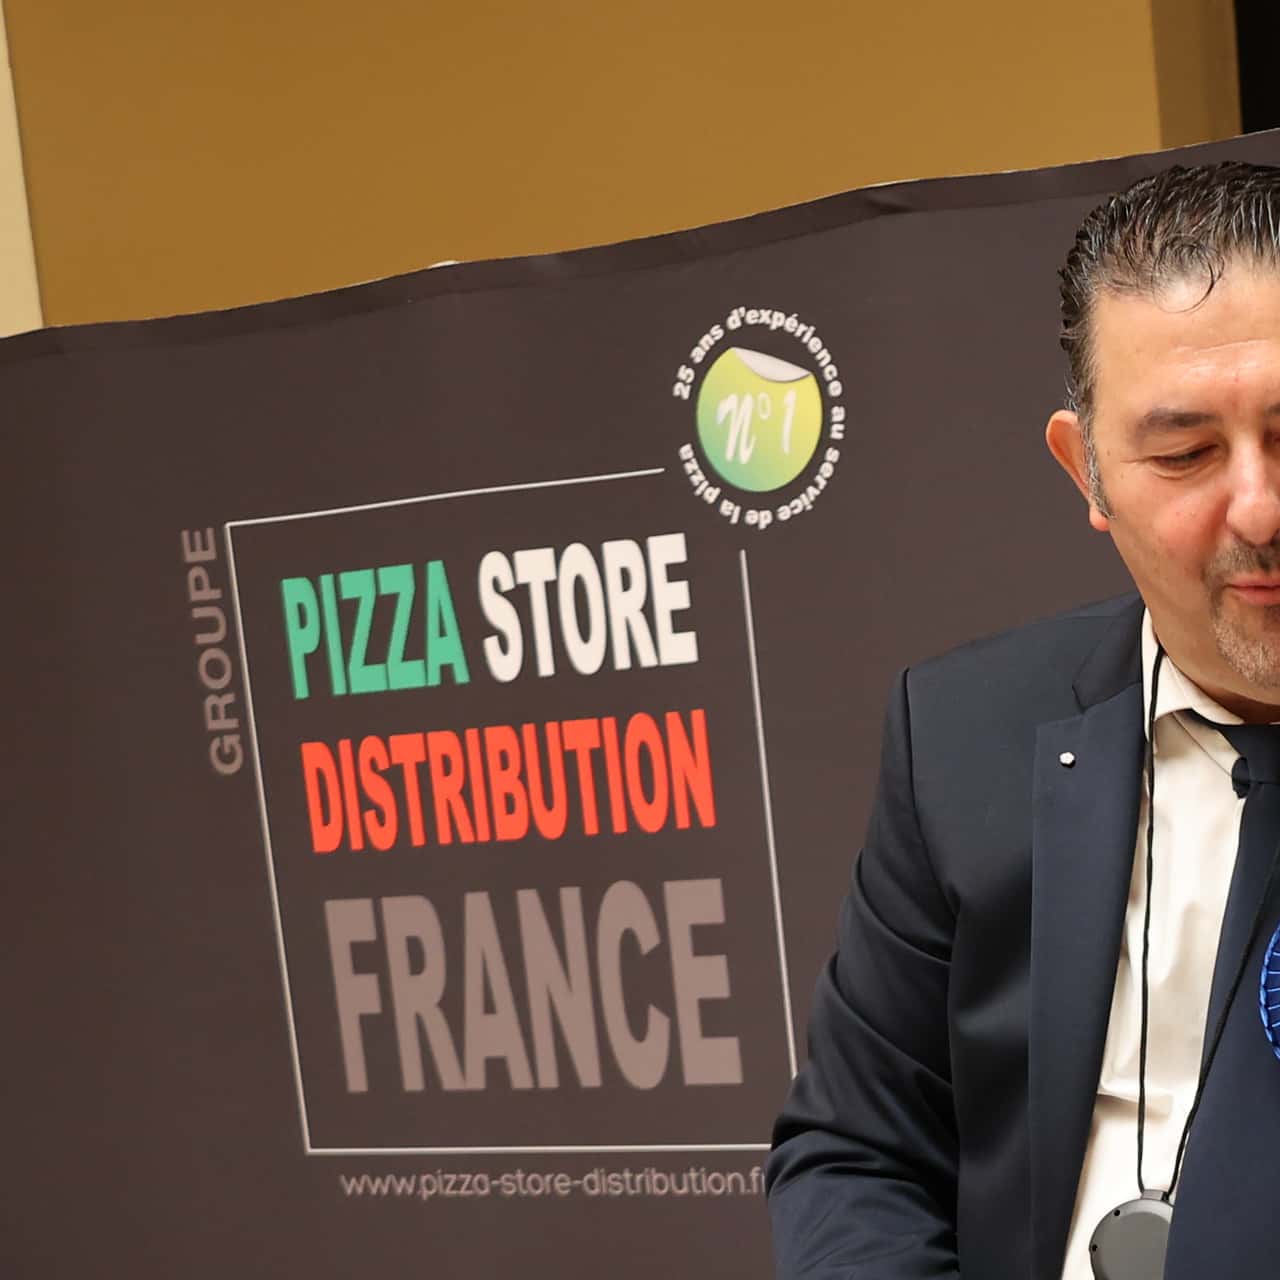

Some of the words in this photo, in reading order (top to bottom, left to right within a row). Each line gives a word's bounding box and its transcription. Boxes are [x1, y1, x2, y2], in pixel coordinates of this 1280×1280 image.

[689, 324, 725, 364] ans
[725, 306, 843, 398] d'expérience
[672, 364, 696, 400] 25
[829, 405, 846, 440] au
[677, 443, 721, 504] pizza
[776, 447, 841, 522] service
[718, 499, 742, 525] la
[744, 508, 774, 530] de
[281, 559, 470, 700] PIZZA
[477, 532, 700, 683] STORE
[181, 527, 244, 776] GROUPE
[300, 707, 718, 855] DISTRIBUTION
[324, 877, 744, 1095] FRANCE
